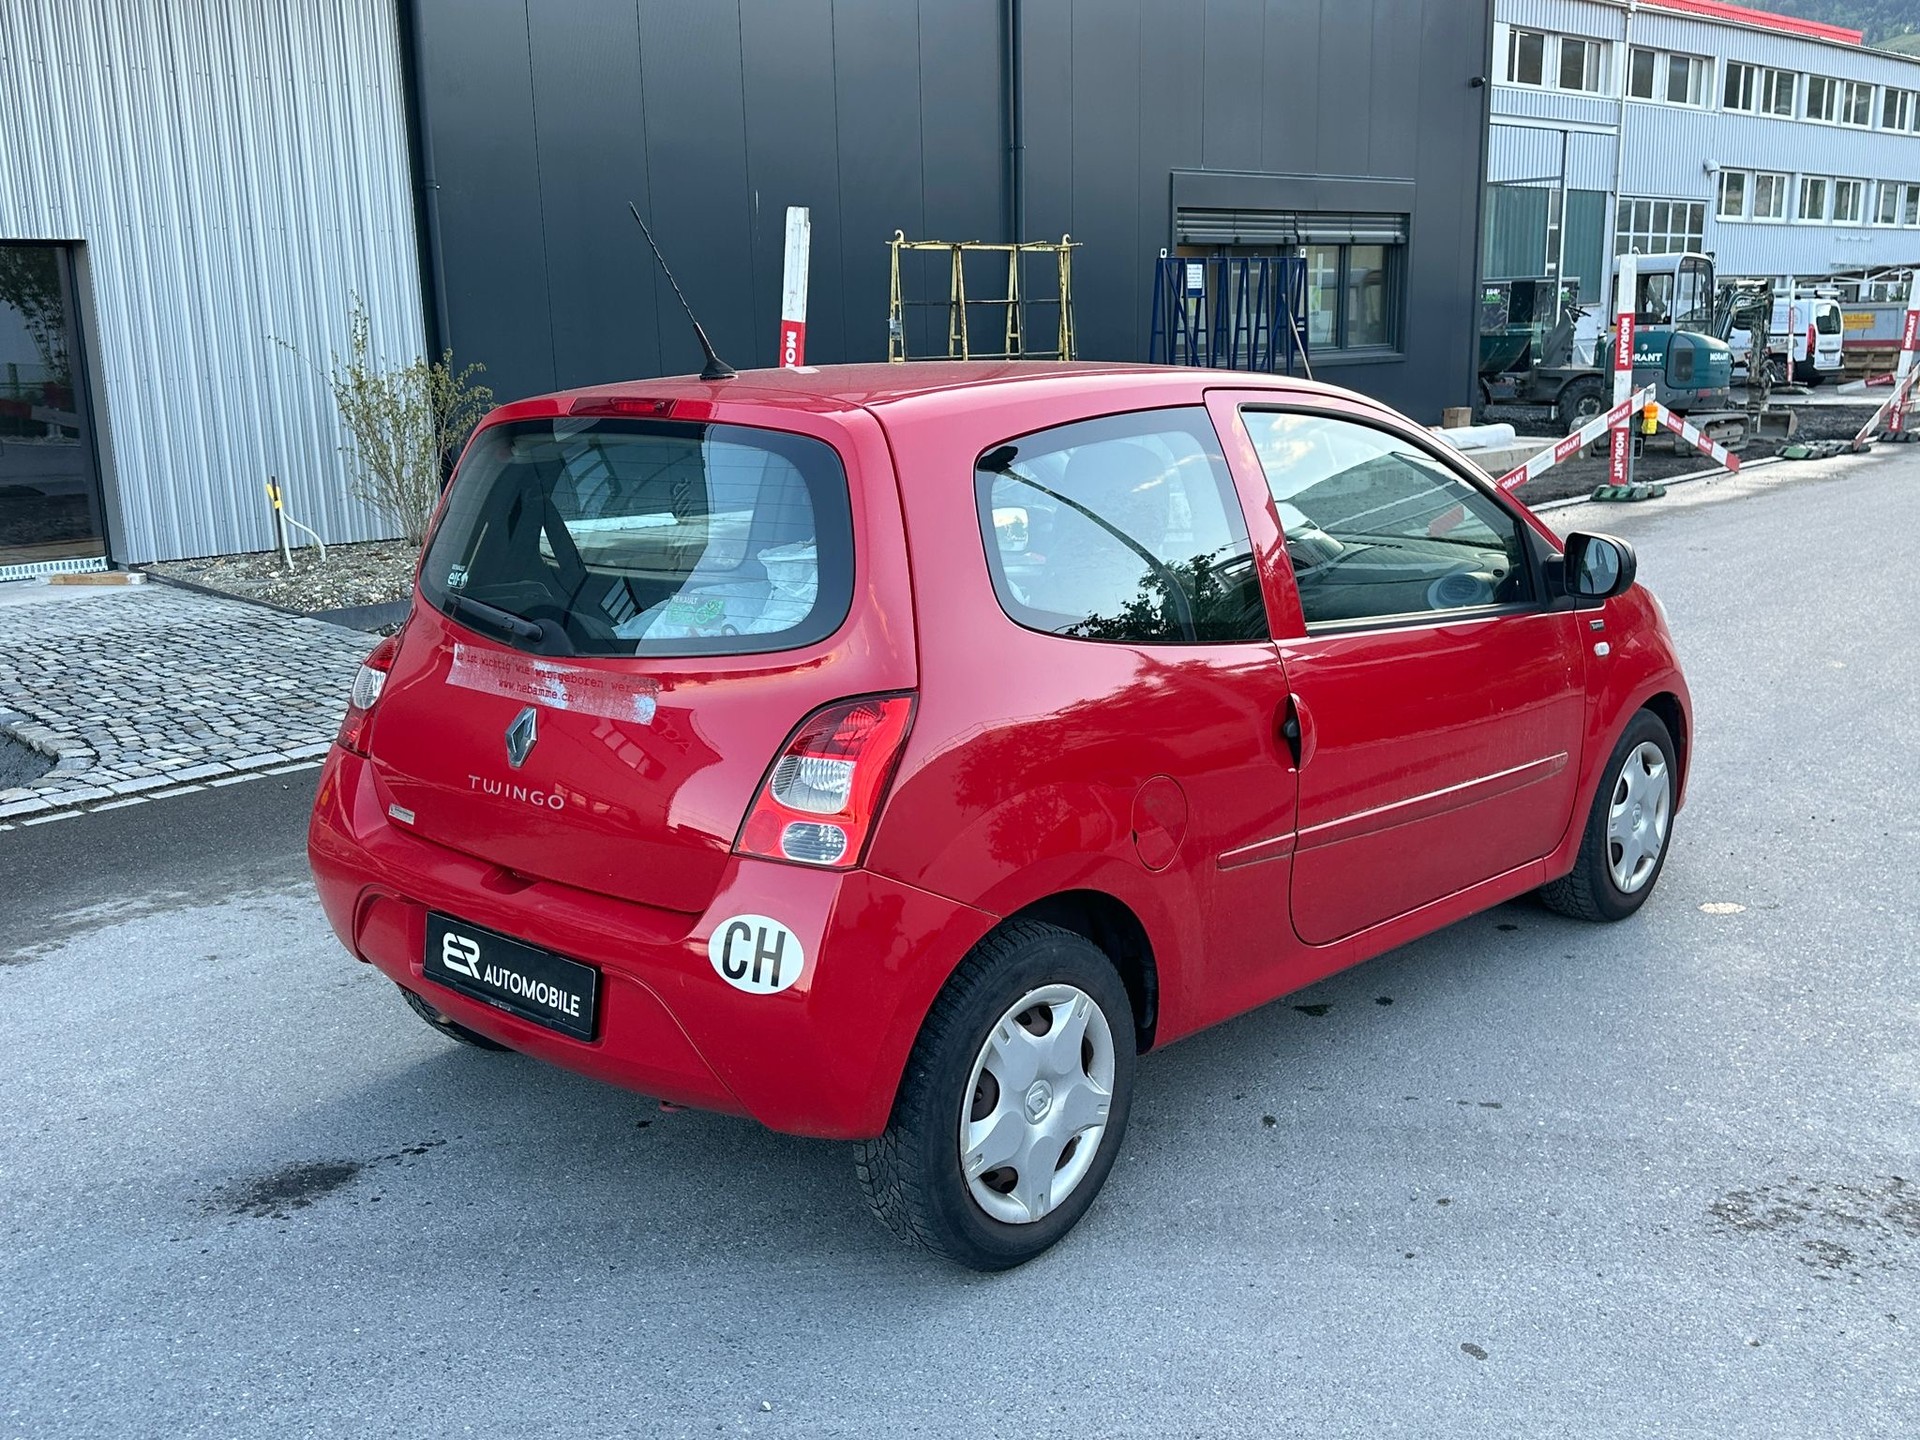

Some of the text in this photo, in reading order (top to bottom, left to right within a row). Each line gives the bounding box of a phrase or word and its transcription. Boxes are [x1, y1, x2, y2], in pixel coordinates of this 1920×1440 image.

[1619, 318, 1630, 366] MORANT
[1608, 405, 1629, 424] MORANT
[1557, 436, 1580, 457] MORANT
[1614, 432, 1625, 479] MORANT
[1501, 470, 1524, 490] ORANT
[448, 572, 461, 585] elf
[467, 654, 478, 663] ist
[482, 657, 510, 674] wichtig
[515, 664, 530, 675] wie
[558, 672, 604, 688] geboren
[498, 678, 574, 702] www.hebamme.ch
[468, 774, 565, 810] TWINGO
[722, 920, 786, 988] CH
[484, 963, 581, 1018] AUTOMOBILE
